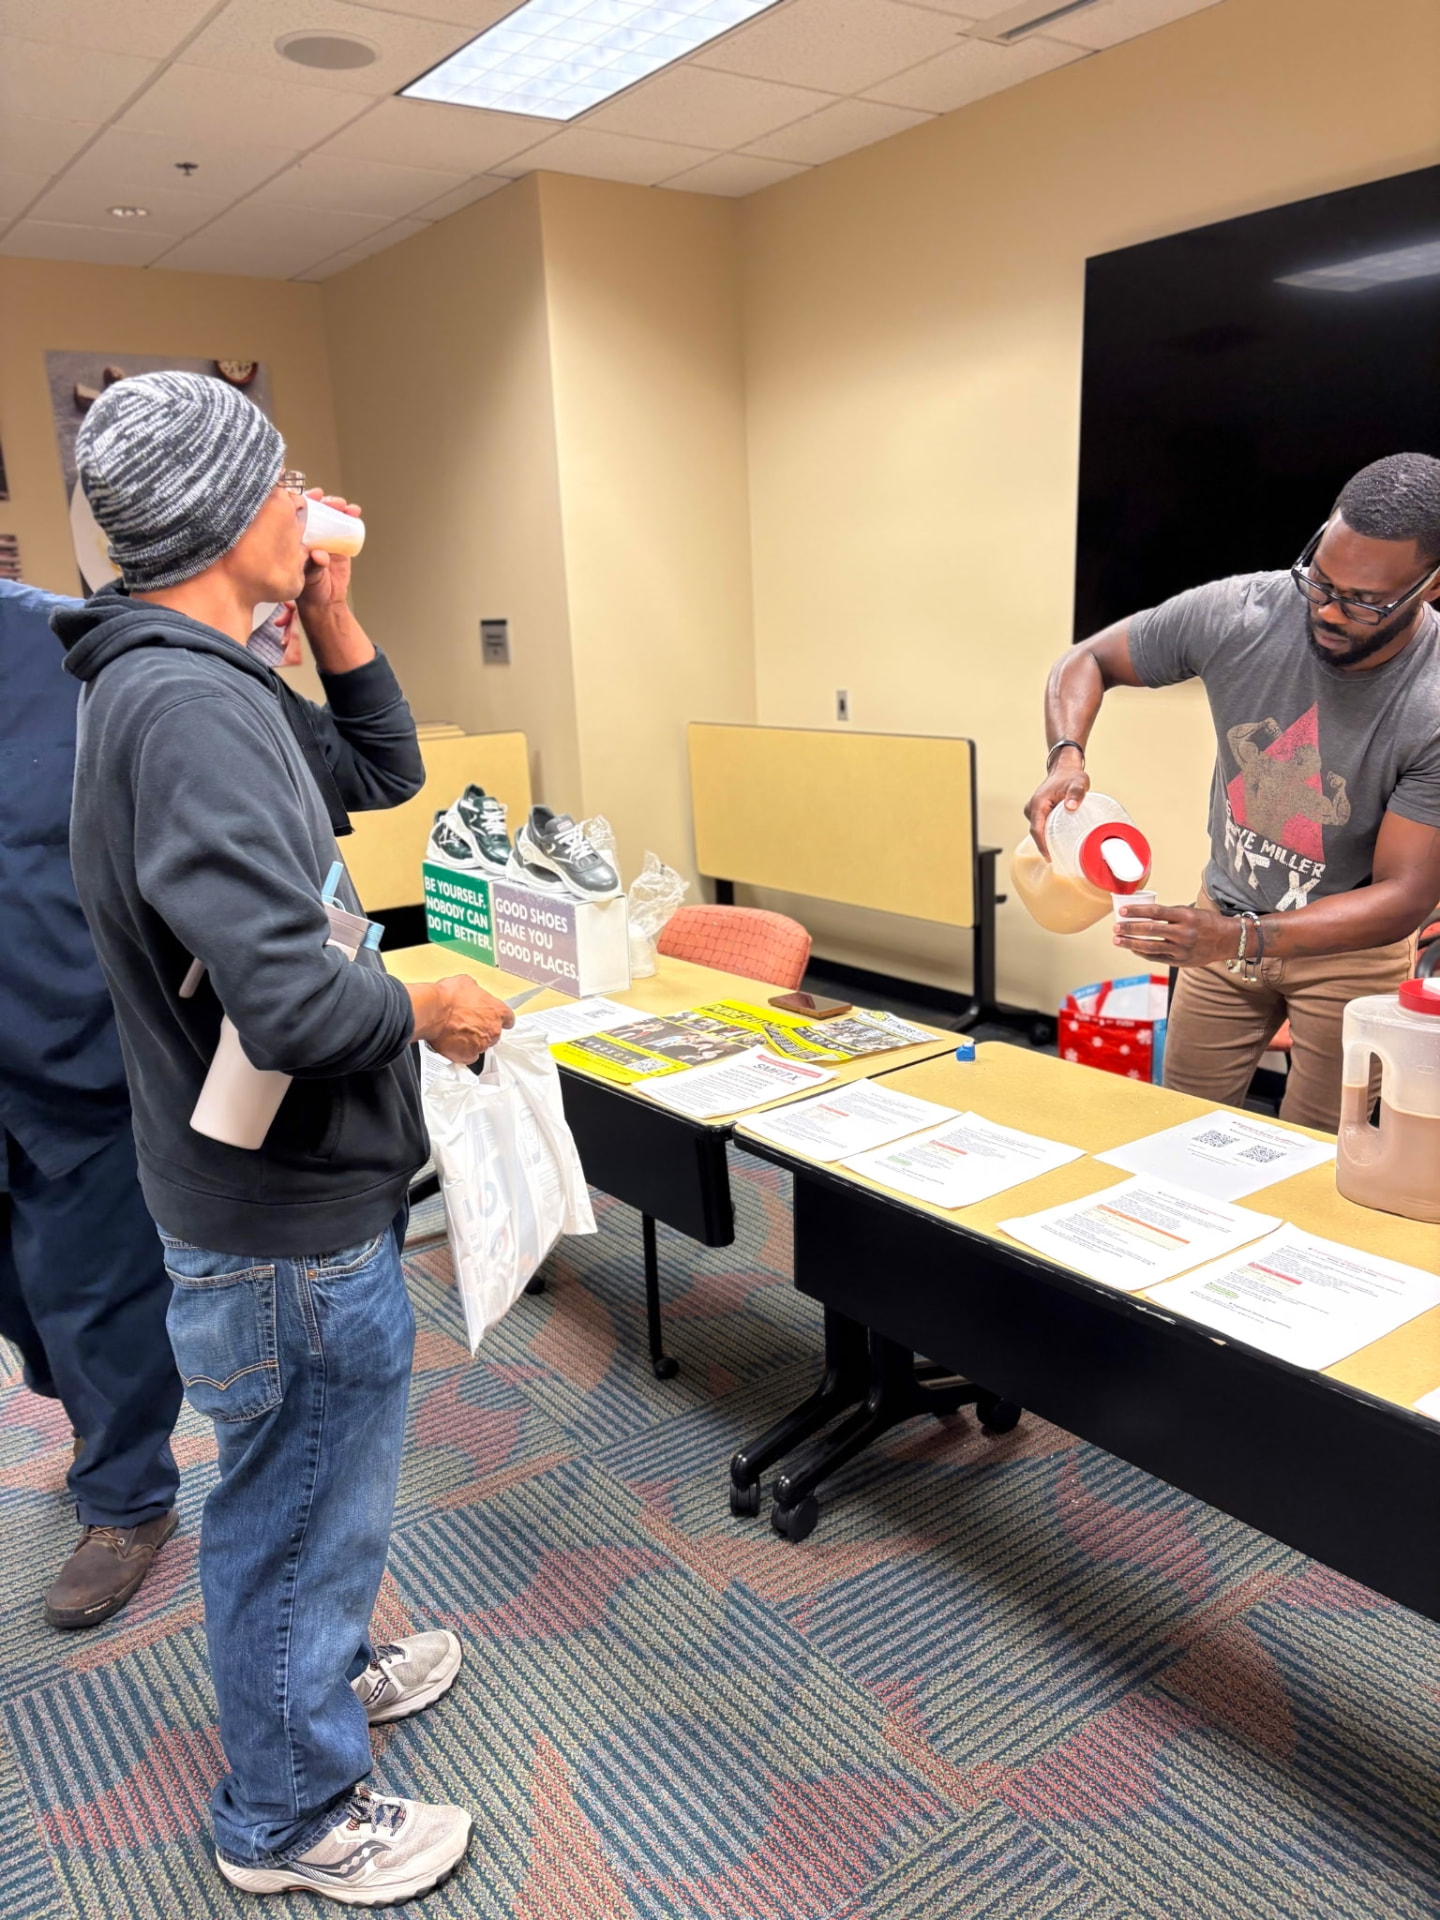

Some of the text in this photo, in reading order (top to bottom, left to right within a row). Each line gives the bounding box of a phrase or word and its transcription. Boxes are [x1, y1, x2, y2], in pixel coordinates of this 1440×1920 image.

[1260, 840, 1326, 878] MILLER
[424, 876, 486, 909] BE YOURSELF.
[426, 895, 488, 930] NOBODY CAN
[496, 897, 568, 933] GOOD SHOES
[428, 915, 492, 951] DO IT BETTER.
[497, 919, 553, 950] TAKE YOU
[499, 940, 580, 981] GOOD PLACES.
